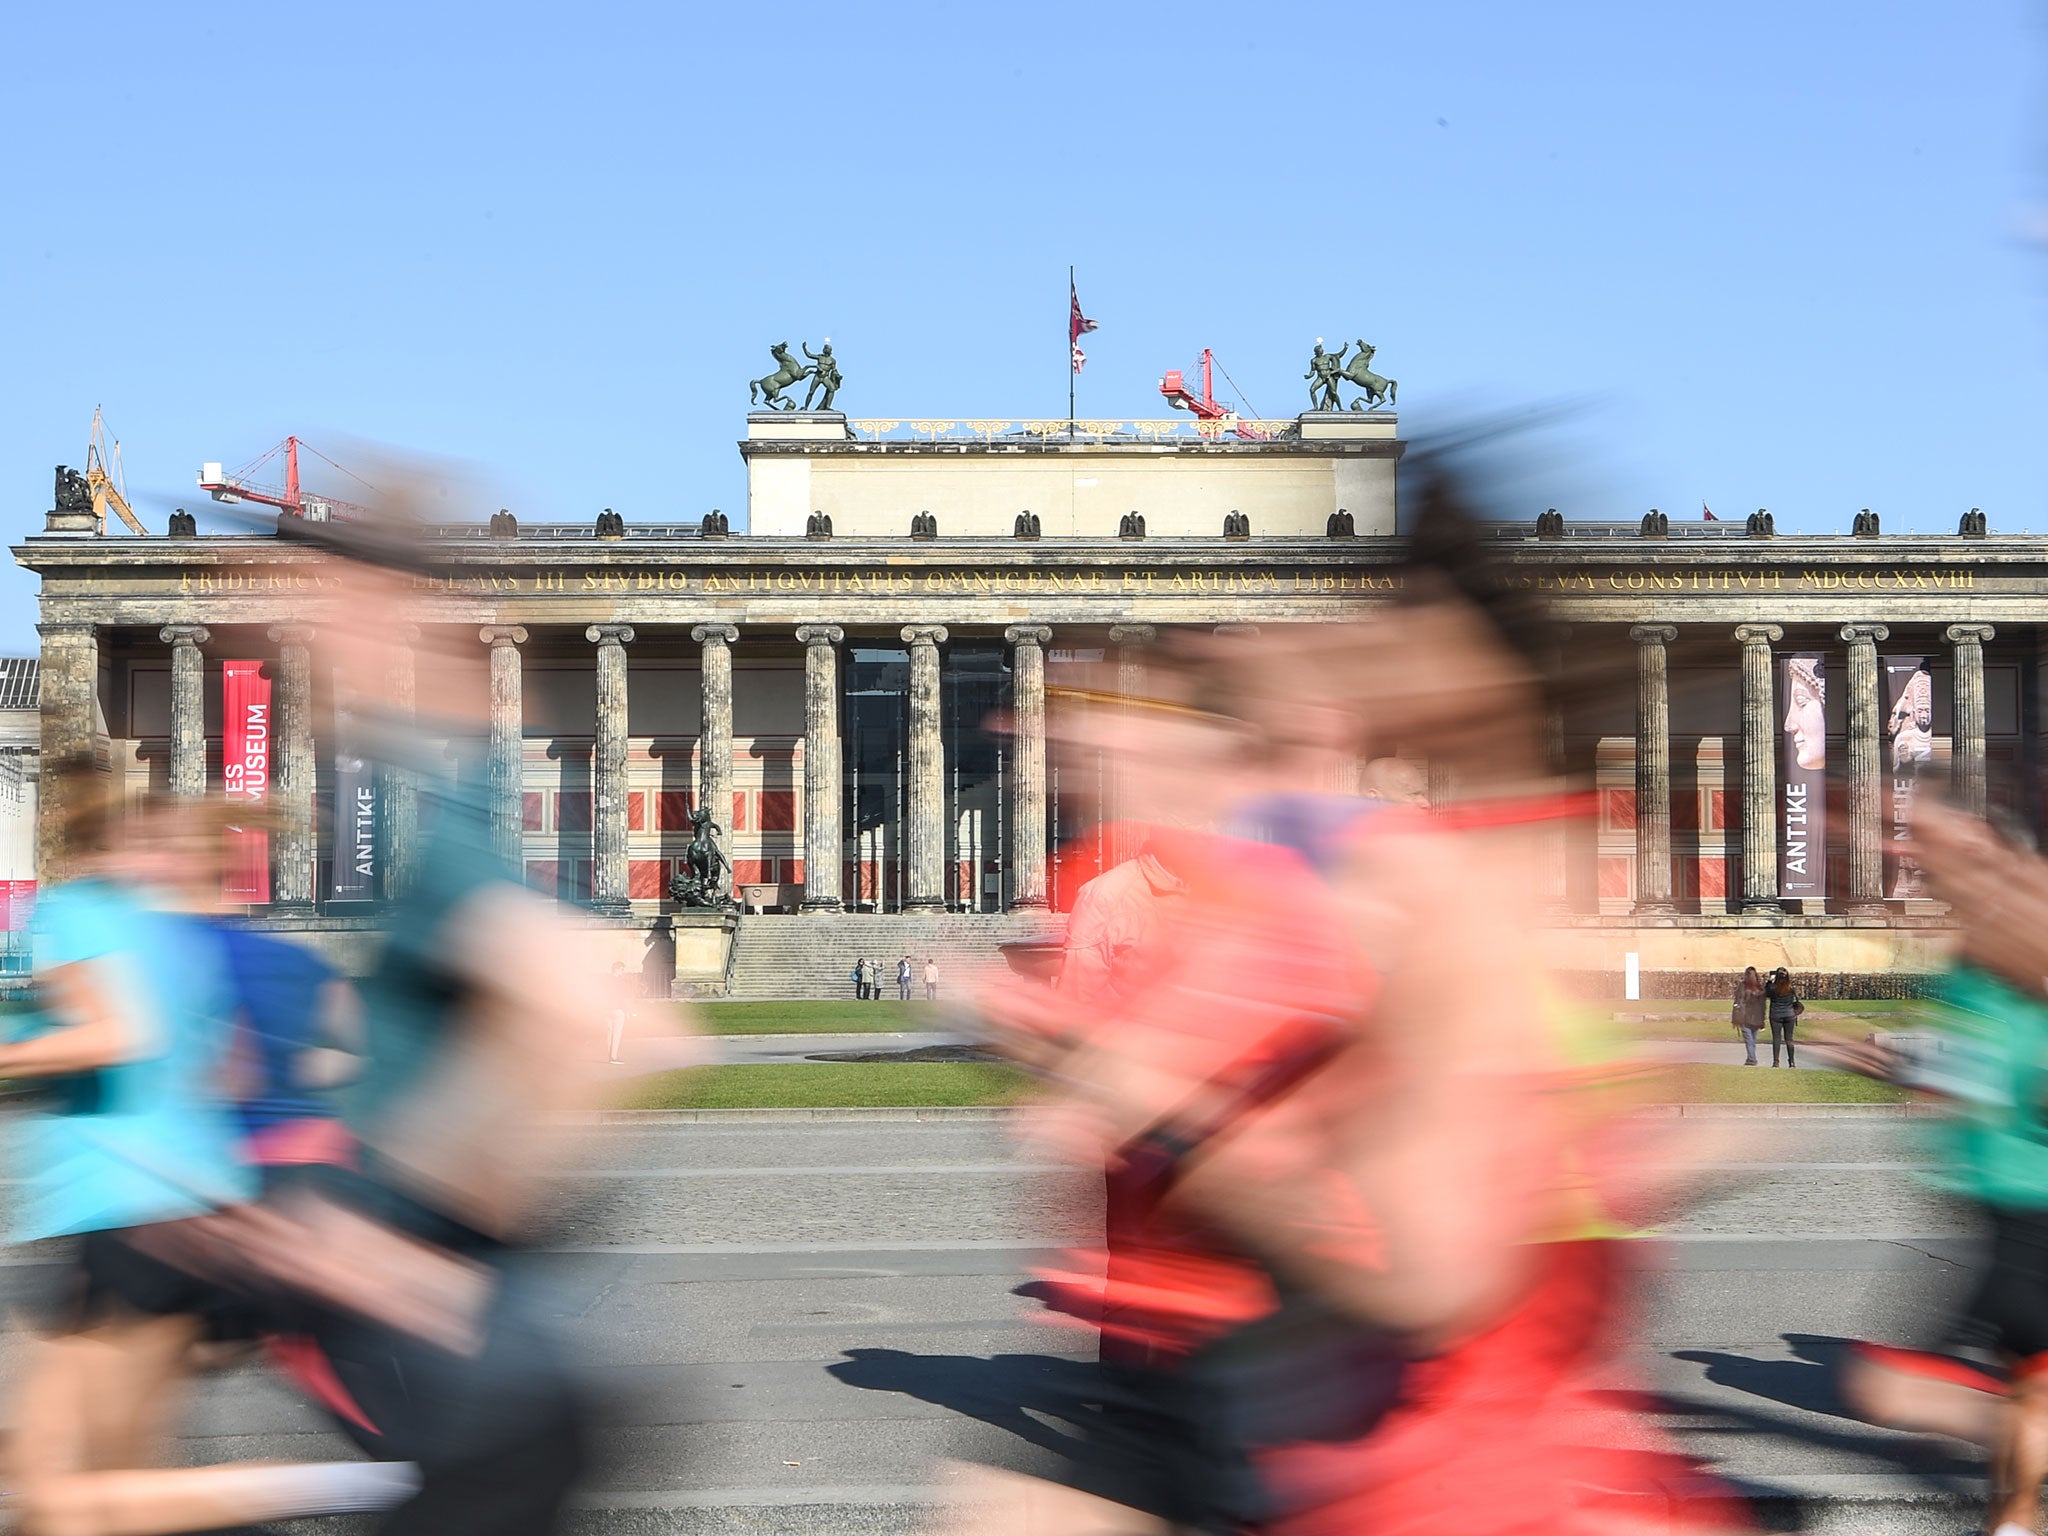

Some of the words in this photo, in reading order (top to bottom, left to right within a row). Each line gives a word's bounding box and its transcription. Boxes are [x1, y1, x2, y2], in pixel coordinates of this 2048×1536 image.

[180, 571, 344, 591] FRIDERICVS
[534, 571, 566, 591] III
[581, 571, 687, 591] STVDIO
[703, 571, 914, 591] ANTIQVITATIS
[926, 571, 1108, 591] OMNIGENAE
[1123, 571, 1158, 590] ET
[1167, 571, 1279, 590] ARTIVM
[1495, 570, 1595, 590] VSEVM
[1609, 570, 1785, 590] CONSTITVIT
[1798, 569, 1975, 590] MDCCCXXVIII
[245, 704, 268, 804] MUSEUM
[1786, 783, 1807, 875] ANTIKE
